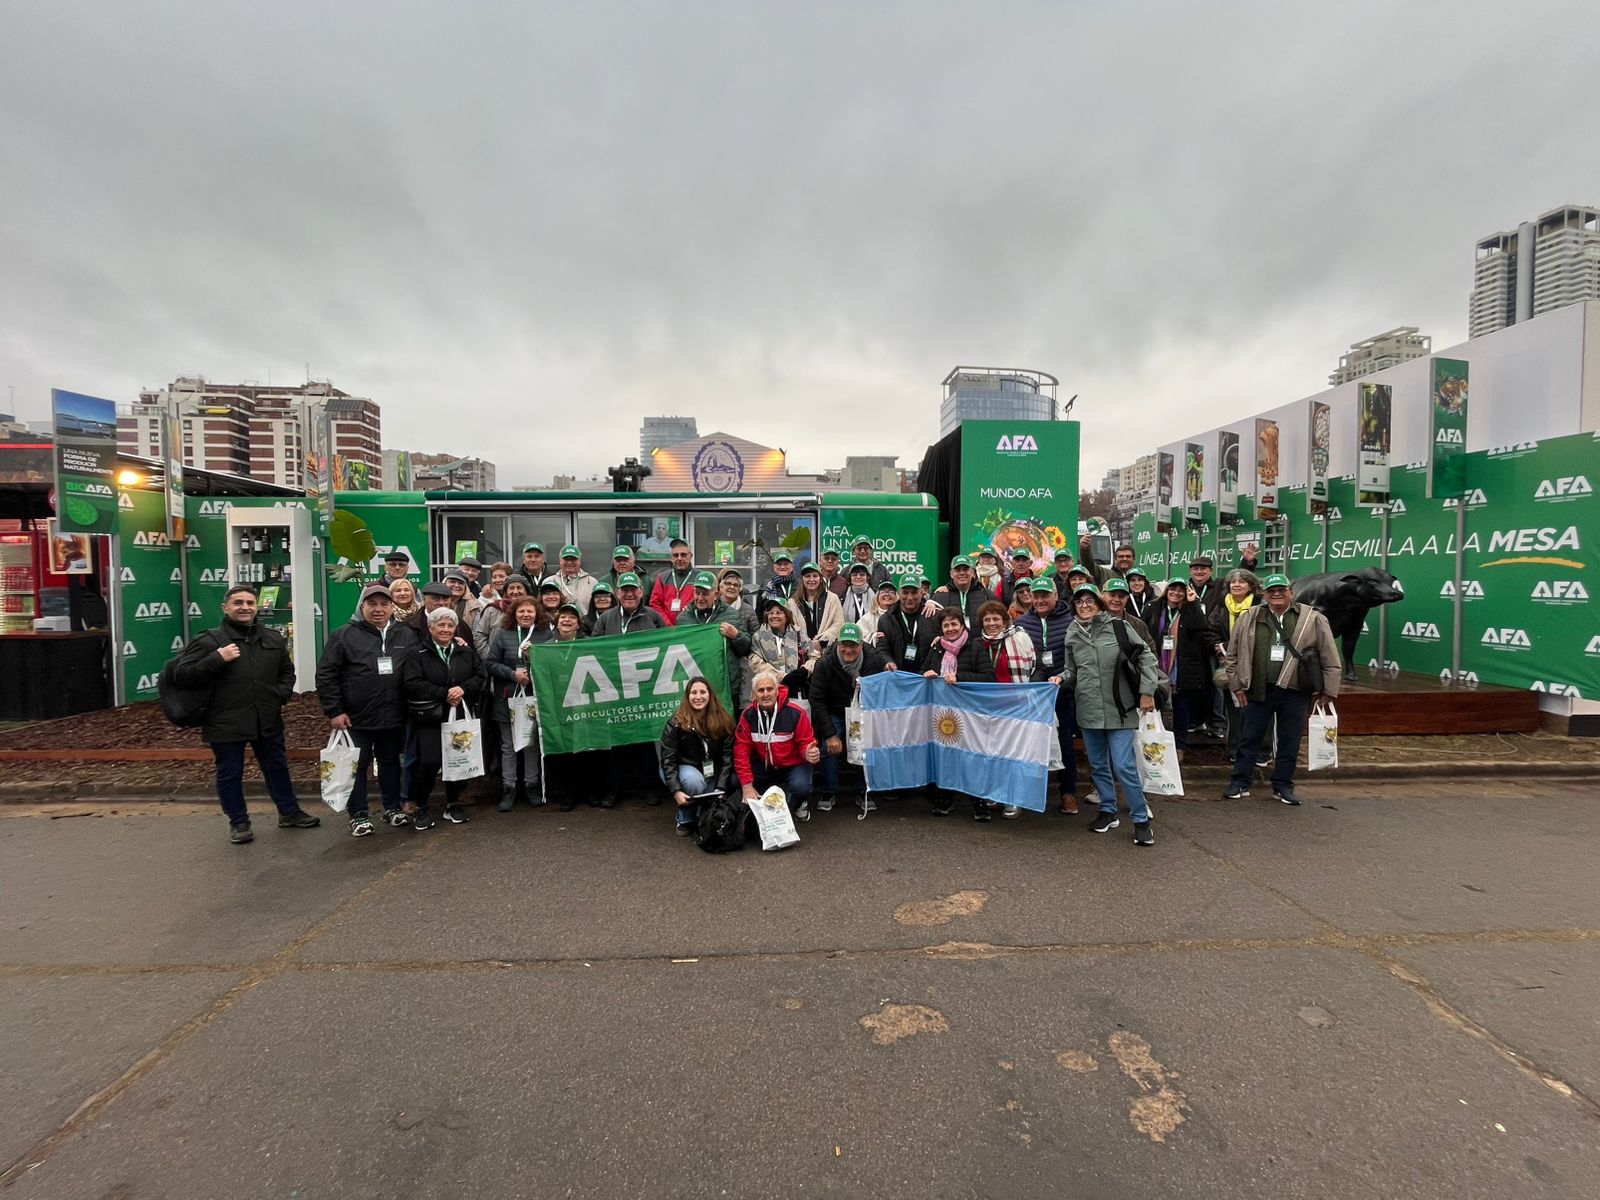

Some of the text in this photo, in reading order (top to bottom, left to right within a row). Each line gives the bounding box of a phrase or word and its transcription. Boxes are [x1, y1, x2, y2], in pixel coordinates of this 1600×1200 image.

[996, 435, 1038, 450] AFA
[1436, 428, 1463, 443] AFA
[63, 453, 87, 461] FORMA
[63, 459, 97, 467] PRODUCIR
[63, 464, 114, 475] NATURALMENTE
[980, 488, 1053, 498] MUNDO AFA
[1534, 476, 1592, 497] AFA
[133, 530, 171, 546] AFA
[823, 526, 853, 536] AFA.
[1138, 531, 1151, 540] AFA
[1139, 551, 1164, 565] LÍNEA
[1330, 536, 1415, 558] SEMILLA
[1420, 534, 1438, 555] A
[1445, 532, 1480, 554] LA
[1488, 525, 1580, 552] MESA
[336, 546, 420, 574] FA
[873, 551, 917, 562] ENTRE
[1531, 581, 1589, 598] AFA
[135, 603, 172, 617] AFA
[1401, 622, 1440, 637] AFA
[1481, 628, 1531, 646] AFA
[136, 673, 160, 690] AF
[563, 644, 704, 708] AFA
[566, 700, 681, 722] AGRICULTORES FEDER
[607, 709, 673, 724] ARGENTINOS
